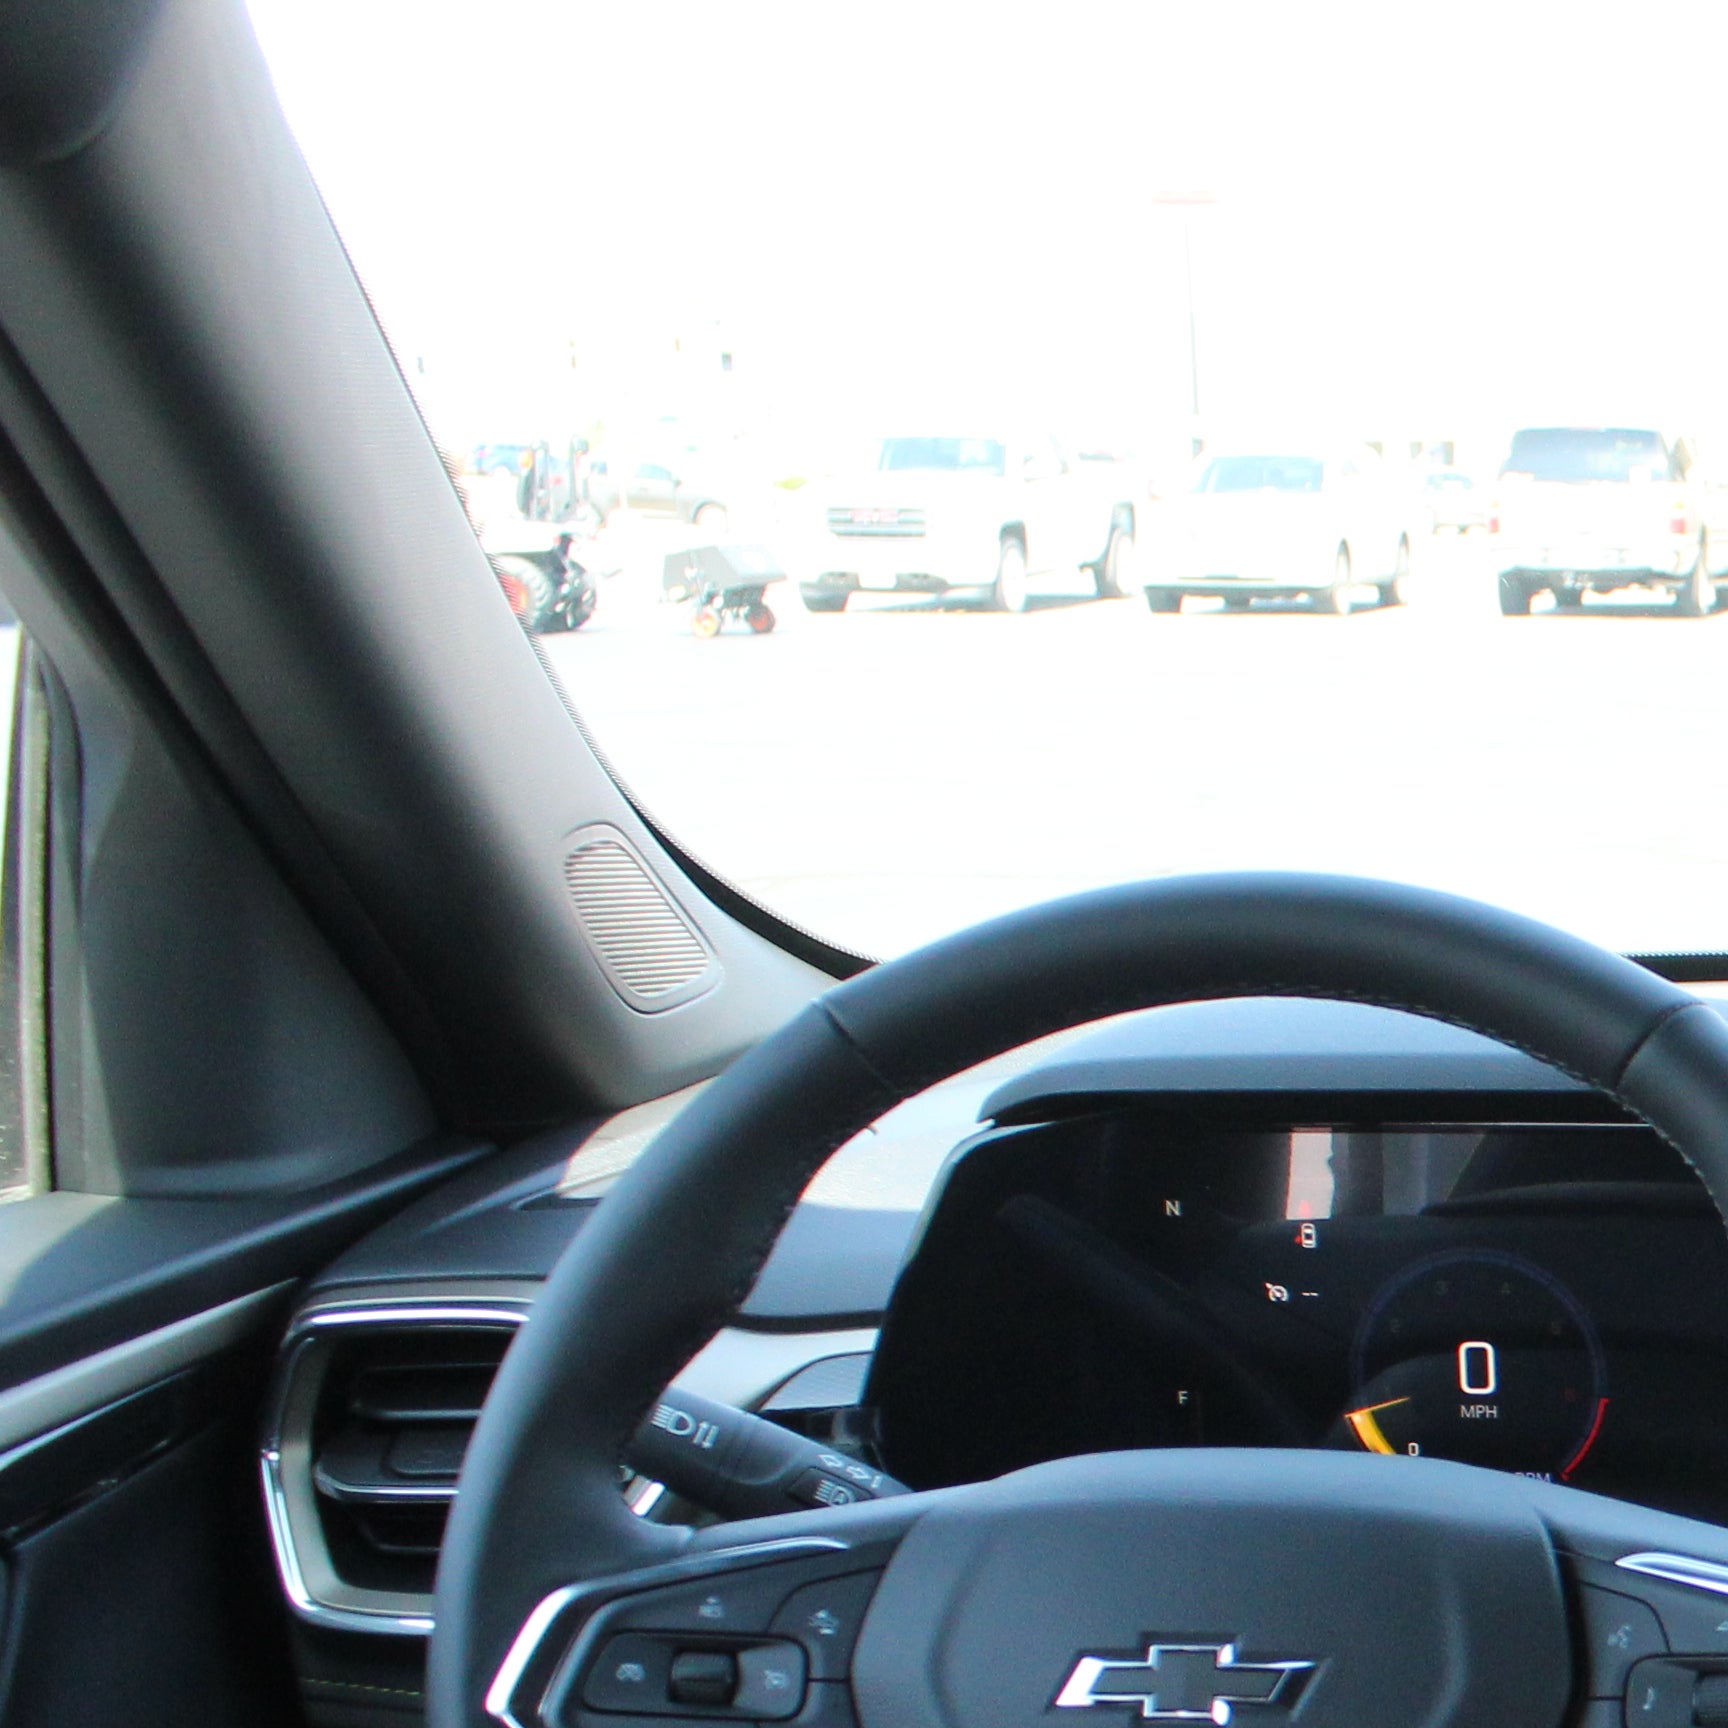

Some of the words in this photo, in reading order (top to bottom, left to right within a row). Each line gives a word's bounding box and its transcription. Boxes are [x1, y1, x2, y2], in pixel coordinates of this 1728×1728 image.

[1165, 1200, 1181, 1216] N
[1458, 1341, 1496, 1394] 0
[1178, 1390, 1188, 1404] F
[1461, 1405, 1497, 1418] MPH
